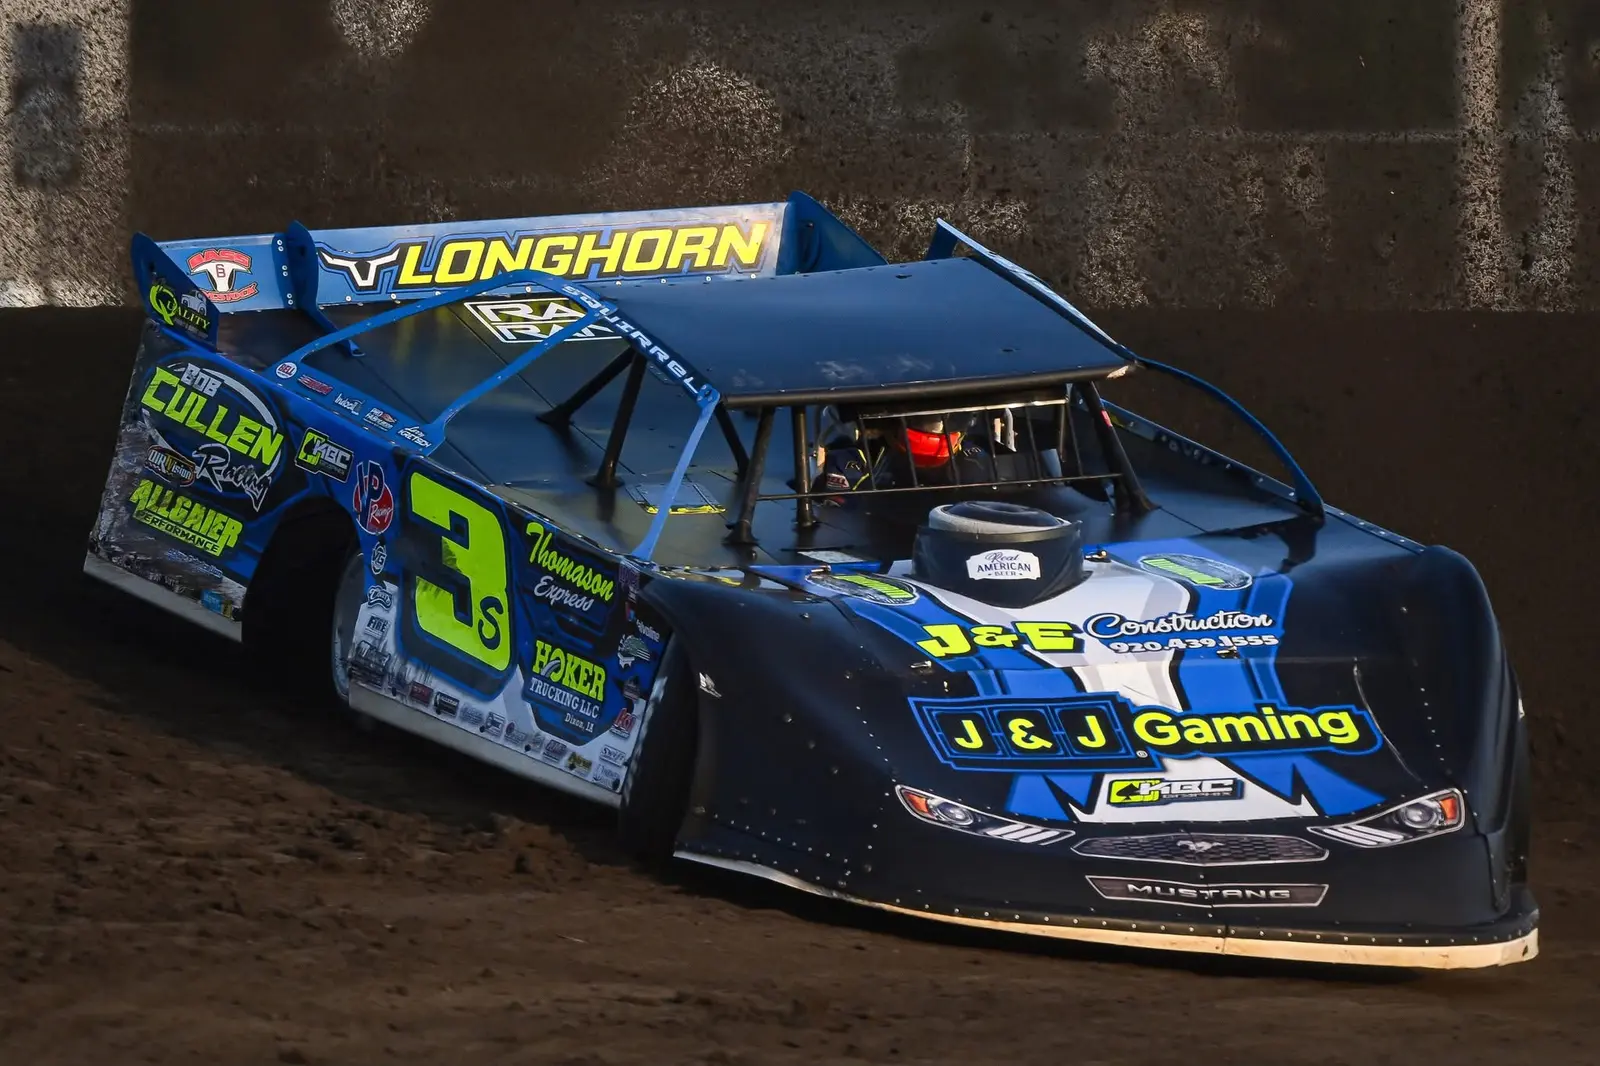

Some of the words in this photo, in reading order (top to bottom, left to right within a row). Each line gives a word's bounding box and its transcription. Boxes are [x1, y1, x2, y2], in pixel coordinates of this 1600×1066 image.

[399, 222, 768, 286] LONGHORN
[180, 363, 224, 397] BOB
[277, 363, 296, 376] BELL
[141, 366, 284, 466] CULLEN
[192, 443, 273, 513] Racing
[138, 511, 220, 553] PERFORMANCE
[410, 472, 511, 672] 3
[525, 521, 615, 602] Thomason
[976, 562, 1032, 573] AMERICAN
[984, 551, 1020, 564] Real
[533, 575, 595, 613] Express
[1086, 609, 1274, 641] Construction
[1107, 634, 1280, 654] 920.439.1555
[531, 640, 607, 702] HOKER
[530, 677, 580, 710] TRUCKING
[579, 698, 601, 719] LLC
[954, 718, 984, 750] J
[1007, 717, 1053, 750] &
[1076, 714, 1107, 749] J
[1133, 706, 1361, 746] Gaming
[1127, 883, 1292, 900] MUSTANG
